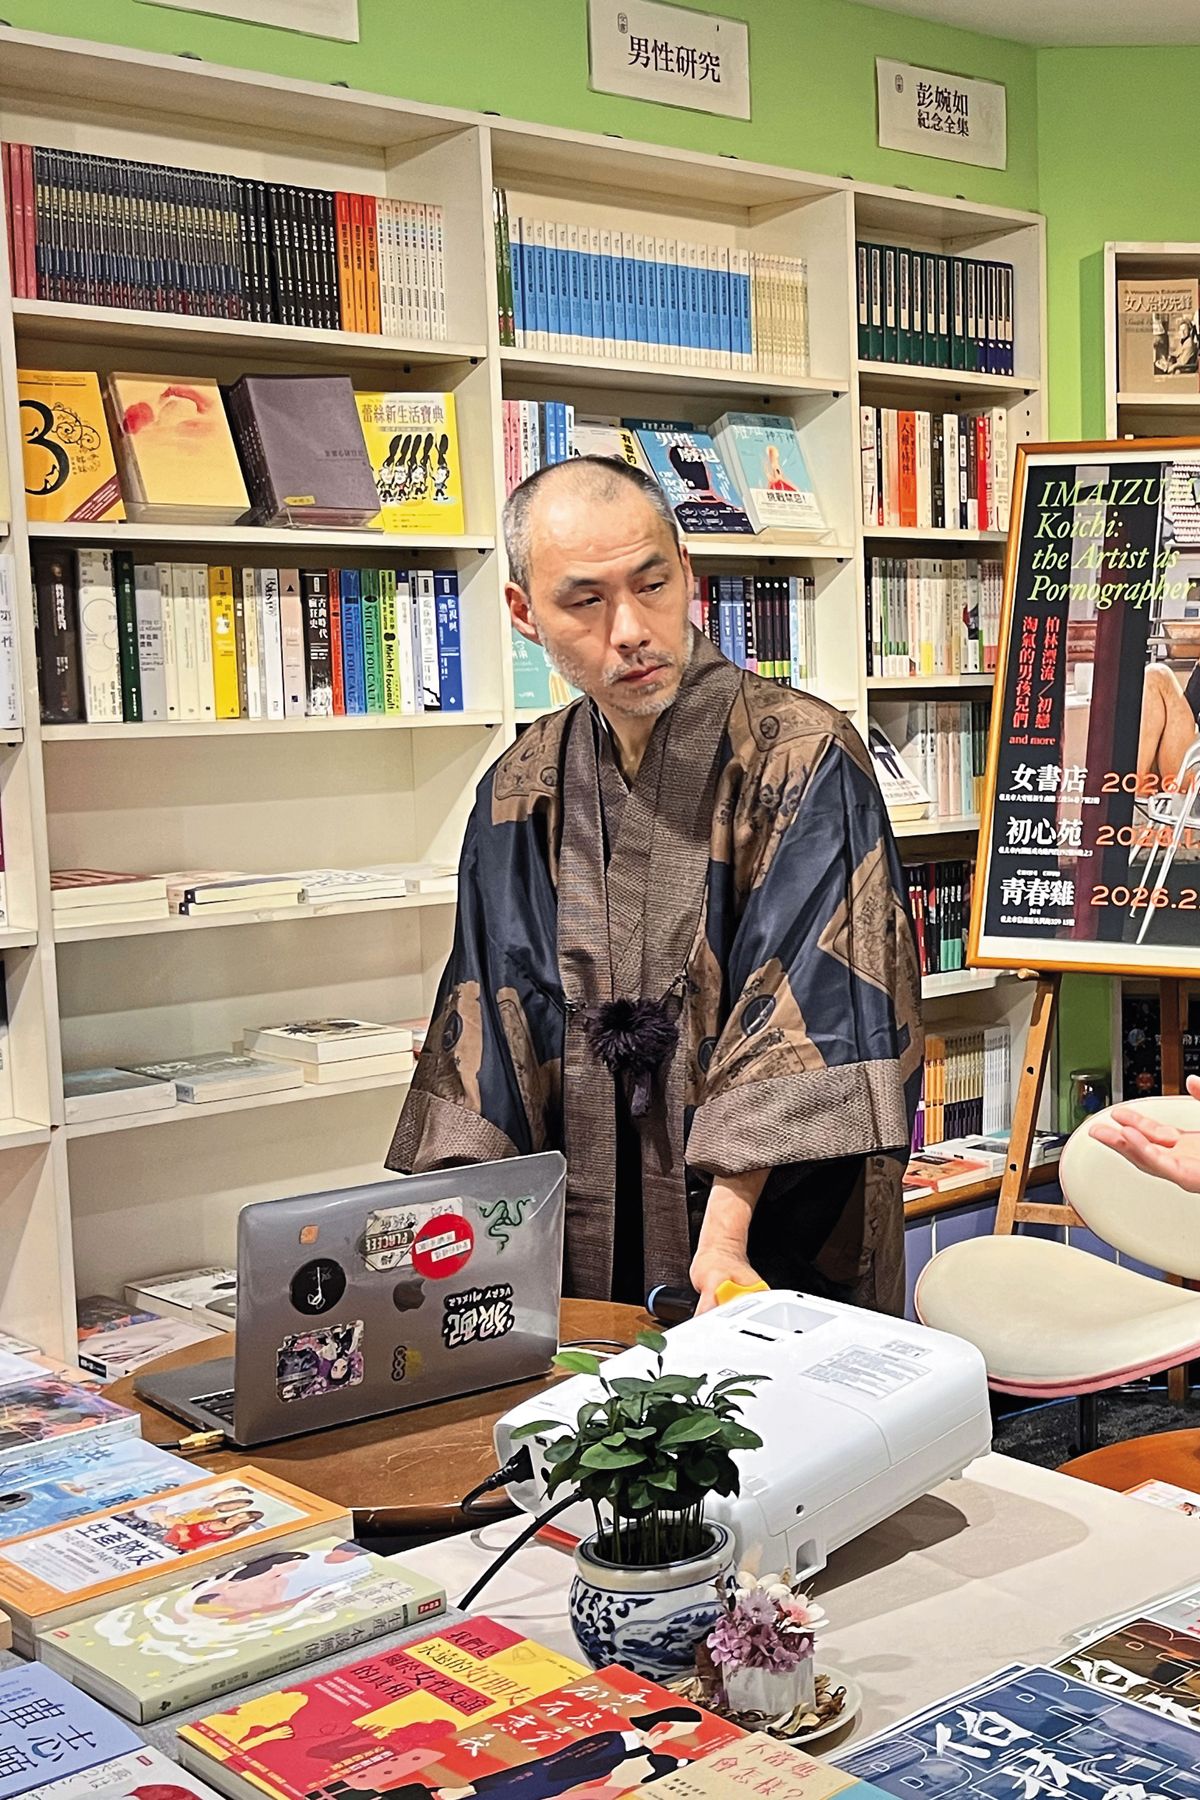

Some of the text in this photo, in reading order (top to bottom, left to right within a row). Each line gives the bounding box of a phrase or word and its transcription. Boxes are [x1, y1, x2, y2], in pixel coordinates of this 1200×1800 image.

[627, 35, 721, 84] 男性研究
[916, 82, 969, 117] 彭婉如
[917, 109, 969, 137] 紀念全集
[361, 404, 445, 425] 蕾絲新生活寶典
[1033, 510, 1124, 539] Koichi:
[1031, 541, 1181, 571] the Artist as
[1026, 570, 1197, 611] Pornographer
[1012, 615, 1038, 729] 淘氣的男孩兒們
[1008, 734, 1056, 746] and more
[1009, 763, 1089, 794] 女書店
[1006, 815, 1084, 847] 初心苑
[1000, 877, 1075, 907] 青春雞
[75, 1522, 164, 1566] 生產隊友
[447, 1629, 501, 1659] 我們是
[350, 1663, 415, 1699] 的真相
[380, 1652, 489, 1713] 關於女性友誼
[418, 1643, 536, 1706] 永遠的好朋友
[708, 1756, 805, 1799] 會怎樣？
[744, 1740, 821, 1780] 不當媽
